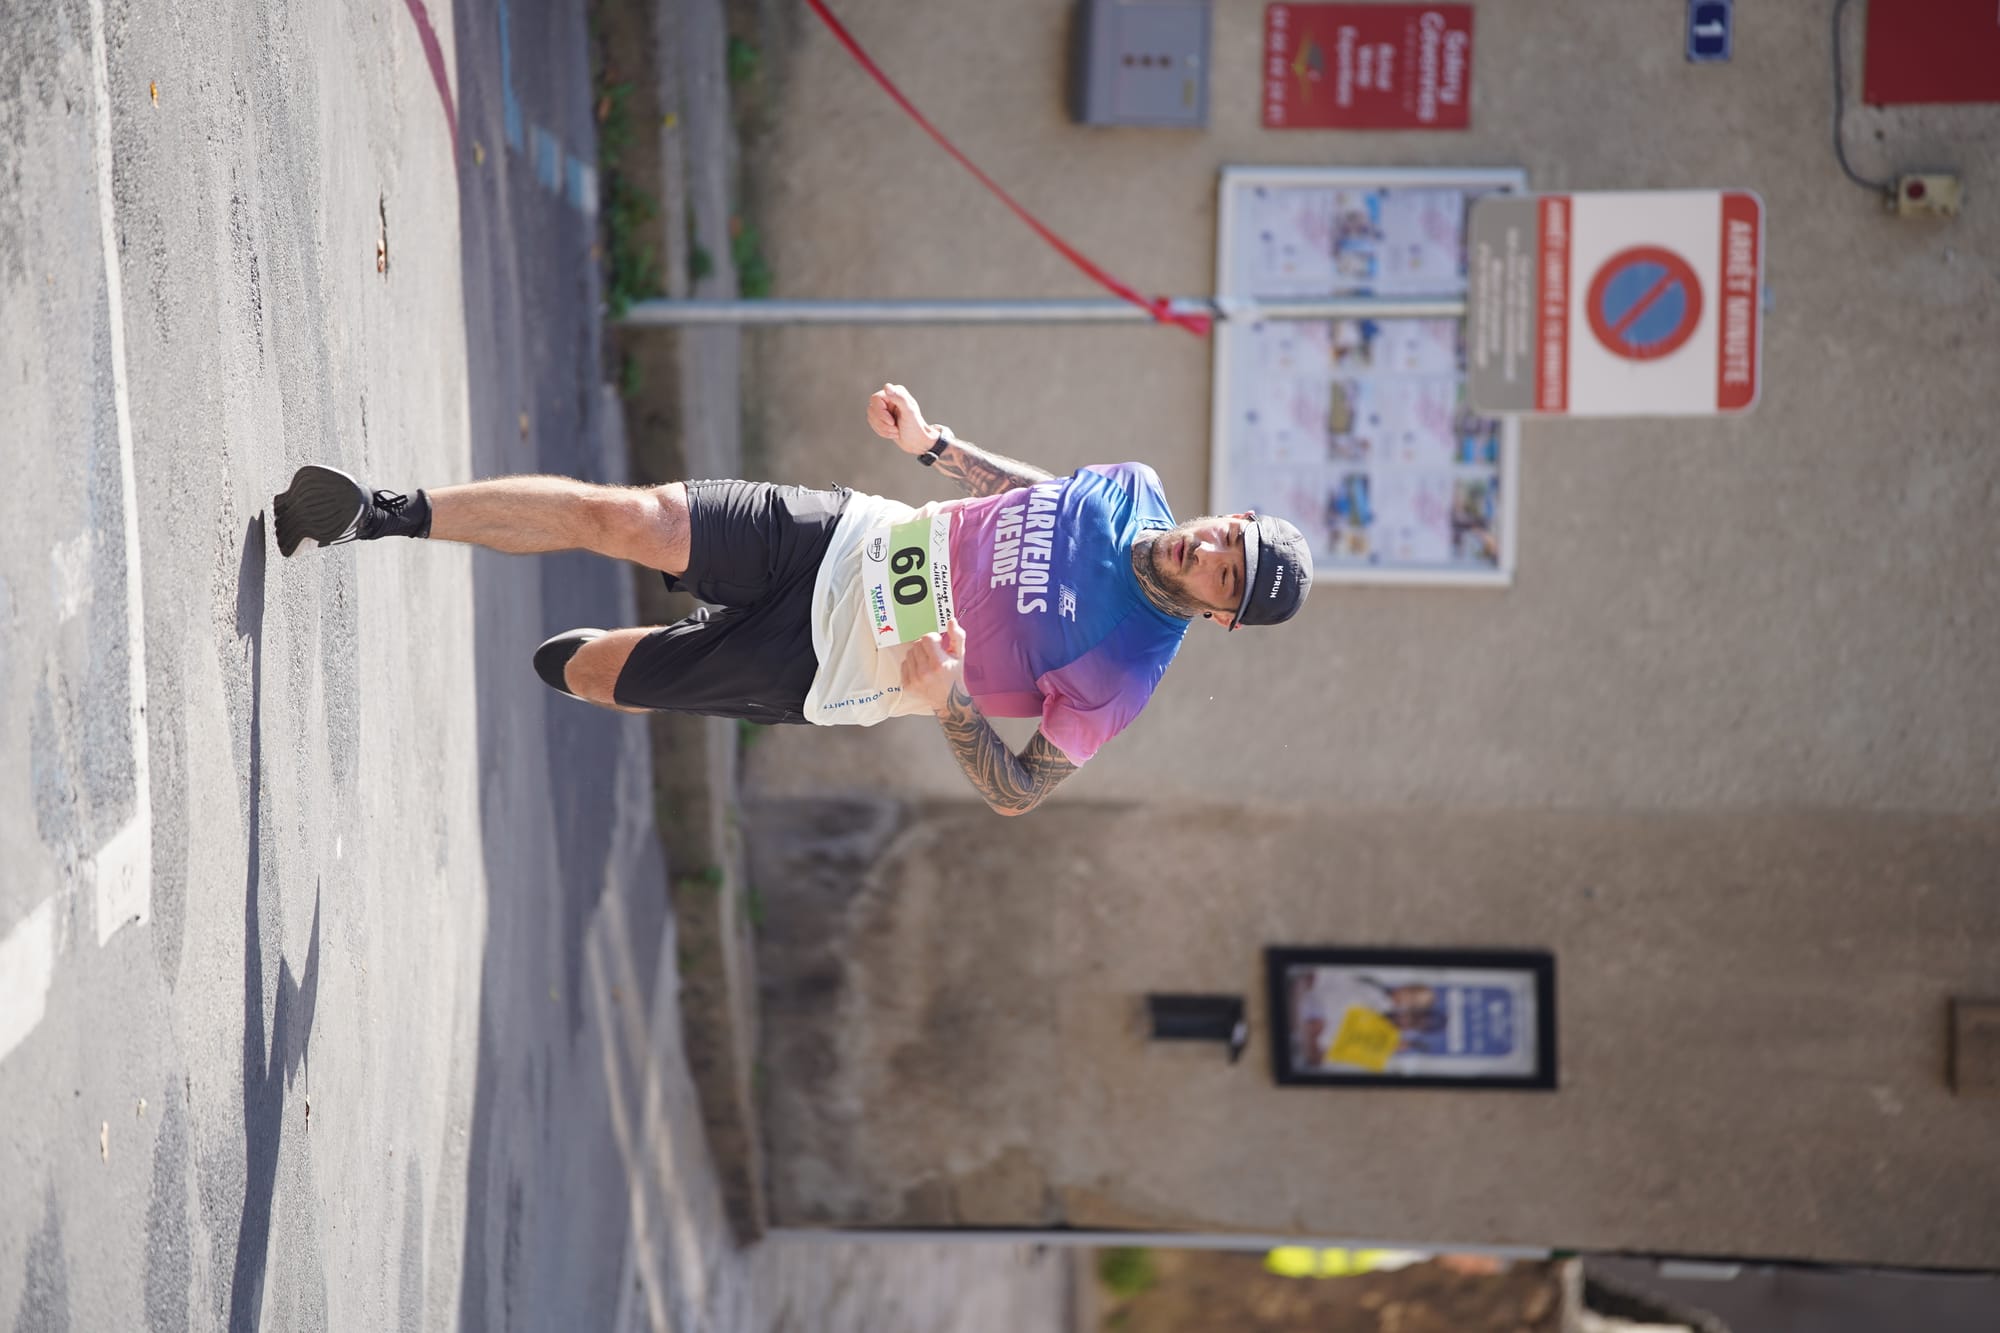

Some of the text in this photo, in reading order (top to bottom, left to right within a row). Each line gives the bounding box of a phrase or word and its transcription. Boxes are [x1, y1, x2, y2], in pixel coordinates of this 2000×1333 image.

[1692, 19, 1724, 36] 1
[1724, 219, 1756, 386] ARRÊT MINUTE
[990, 504, 1026, 589] MENDE
[1017, 484, 1063, 615] MARVEJOLS
[891, 546, 929, 606] 60
[940, 564, 949, 603] Challenge
[1270, 565, 1284, 598] KIPRUN
[874, 584, 888, 622] TUFF'S
[858, 691, 884, 704] YOUR
